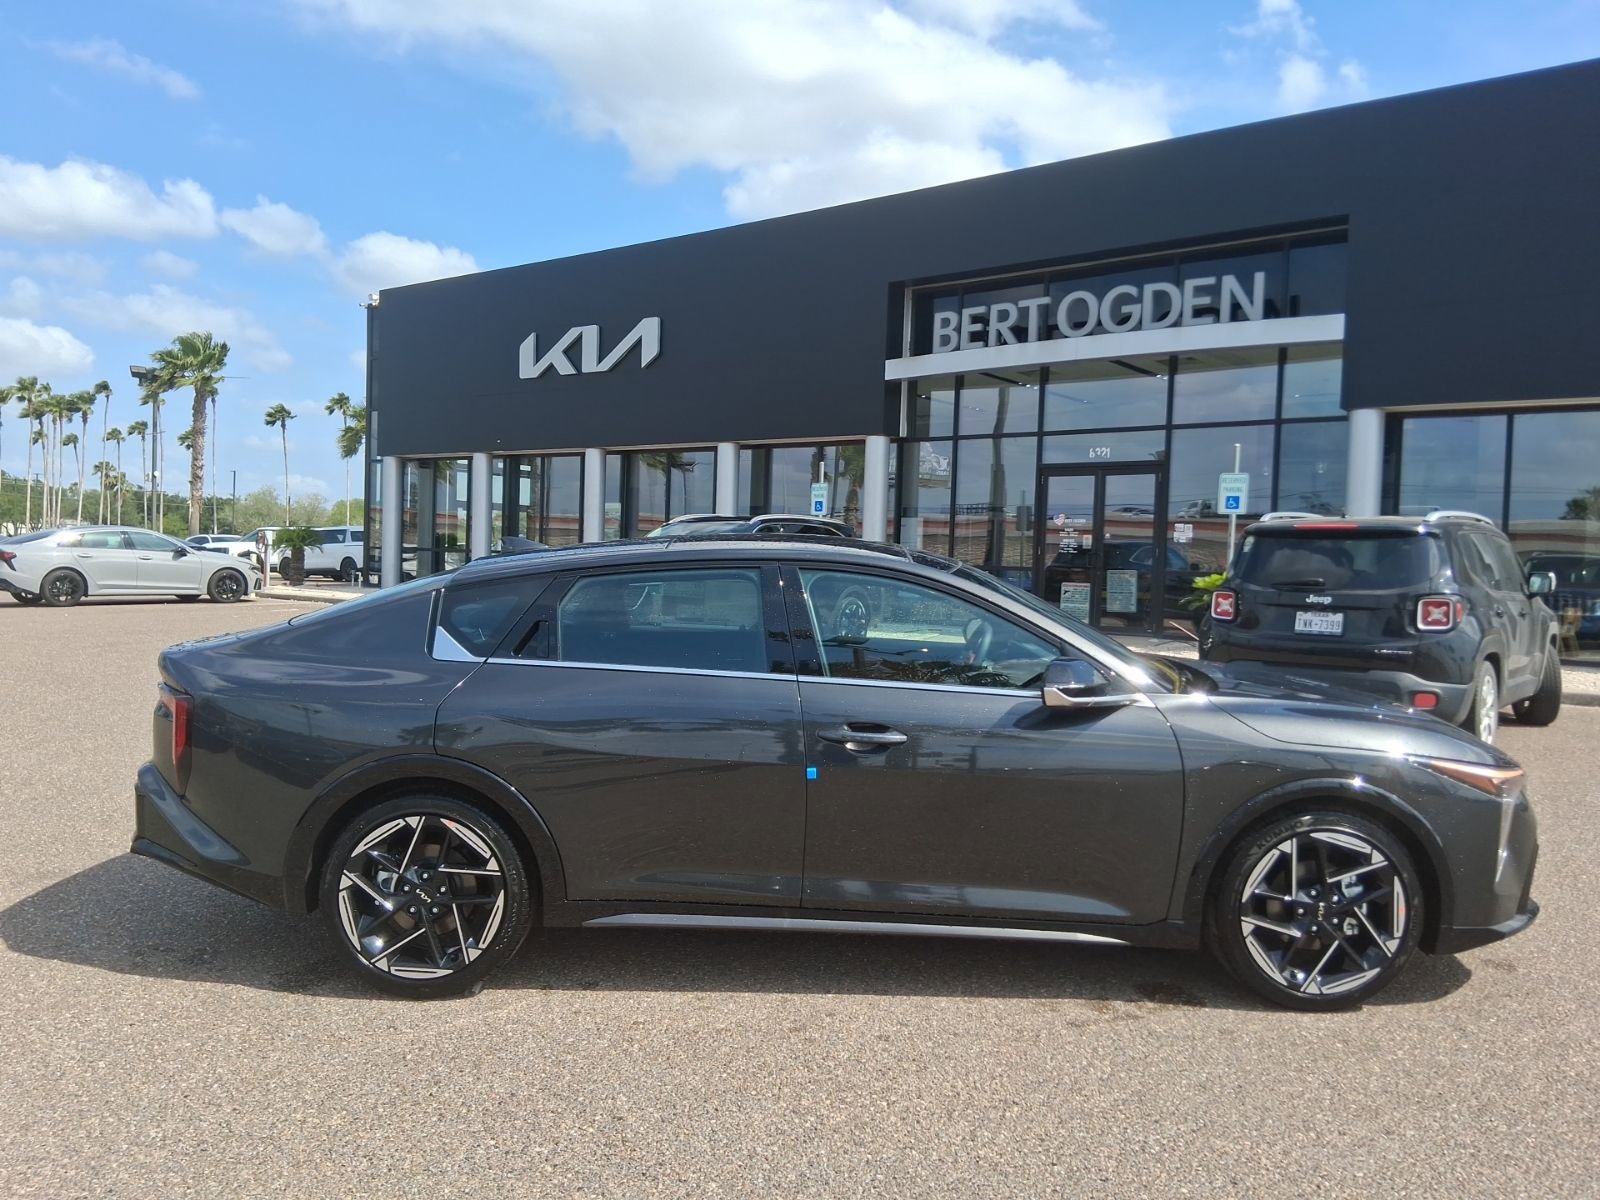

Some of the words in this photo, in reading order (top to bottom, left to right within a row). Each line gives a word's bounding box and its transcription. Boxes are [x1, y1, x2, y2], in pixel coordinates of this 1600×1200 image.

[933, 296, 1051, 354] BERT
[1057, 271, 1265, 338] OGDEN
[519, 316, 660, 379] KIA
[1305, 594, 1332, 605] Jeep
